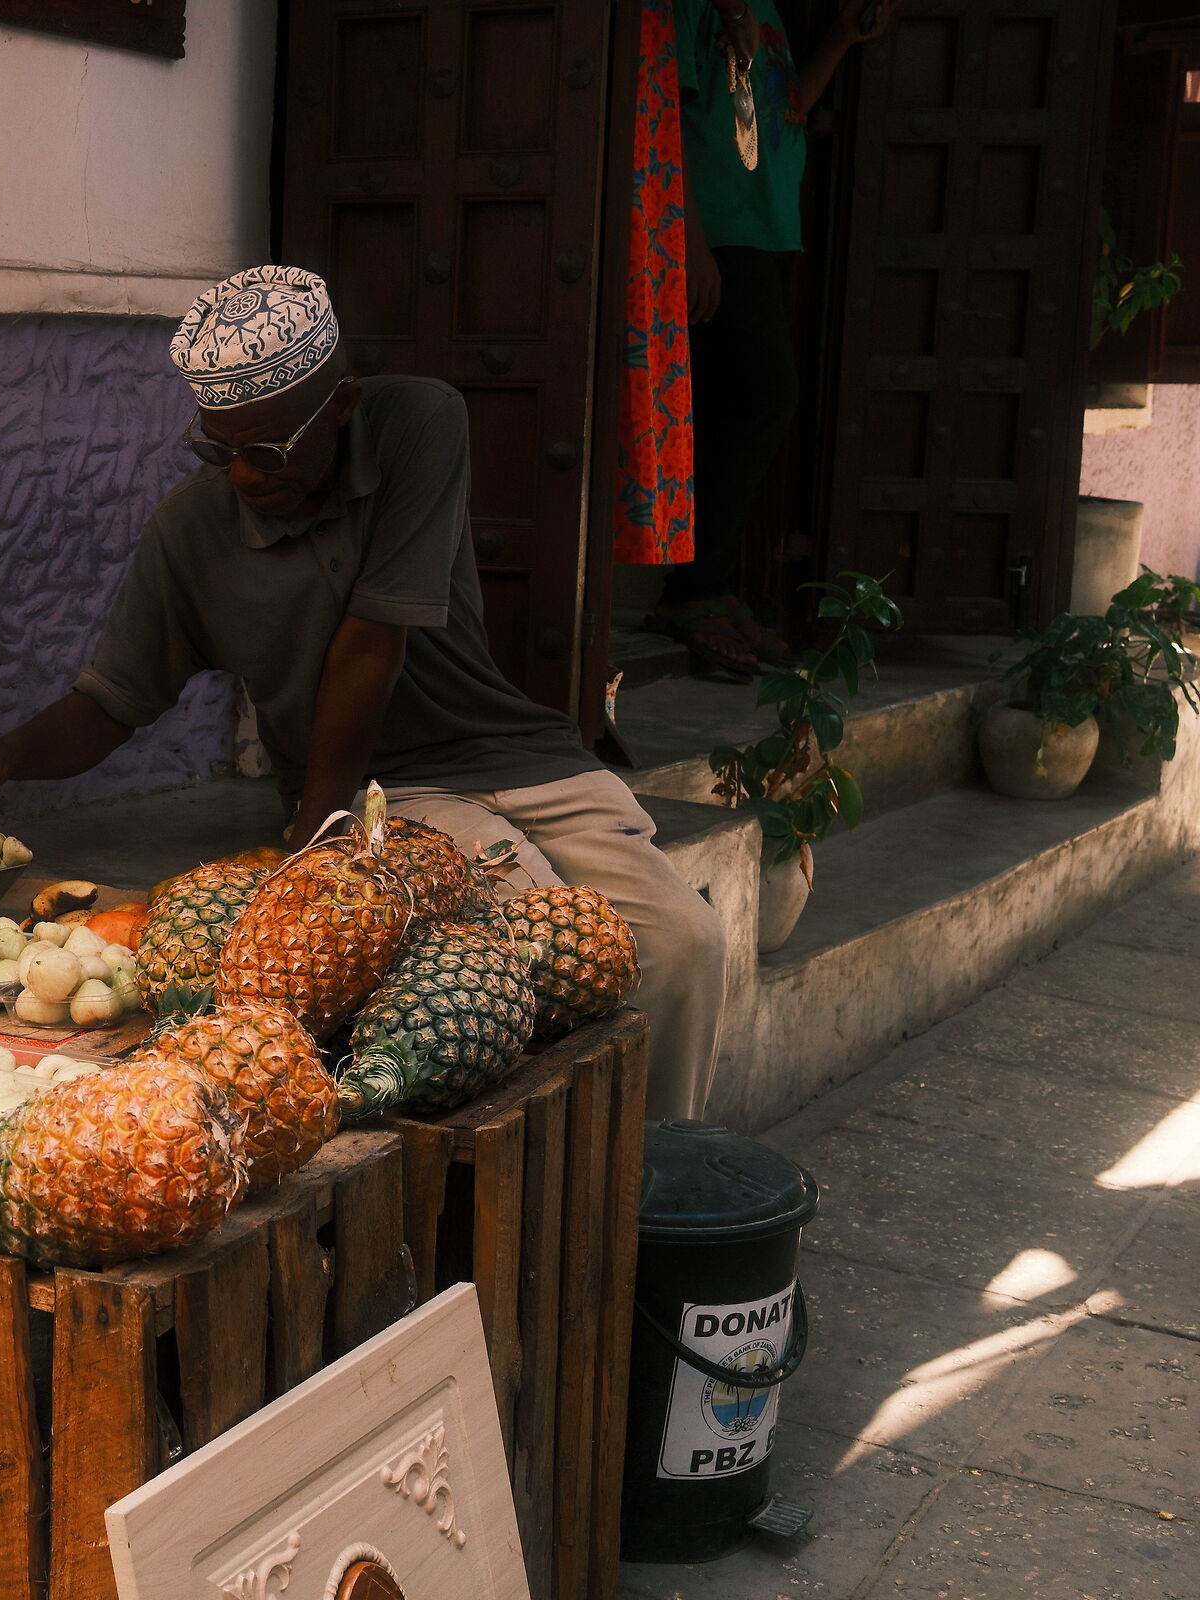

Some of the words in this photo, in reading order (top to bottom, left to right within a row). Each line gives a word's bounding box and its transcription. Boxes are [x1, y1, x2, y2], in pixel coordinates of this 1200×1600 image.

[694, 1293, 791, 1337] DONAT
[704, 1389, 712, 1404] THE
[734, 1344, 751, 1358] BANK
[752, 1341, 760, 1349] OF
[690, 1440, 756, 1473] PBZ
